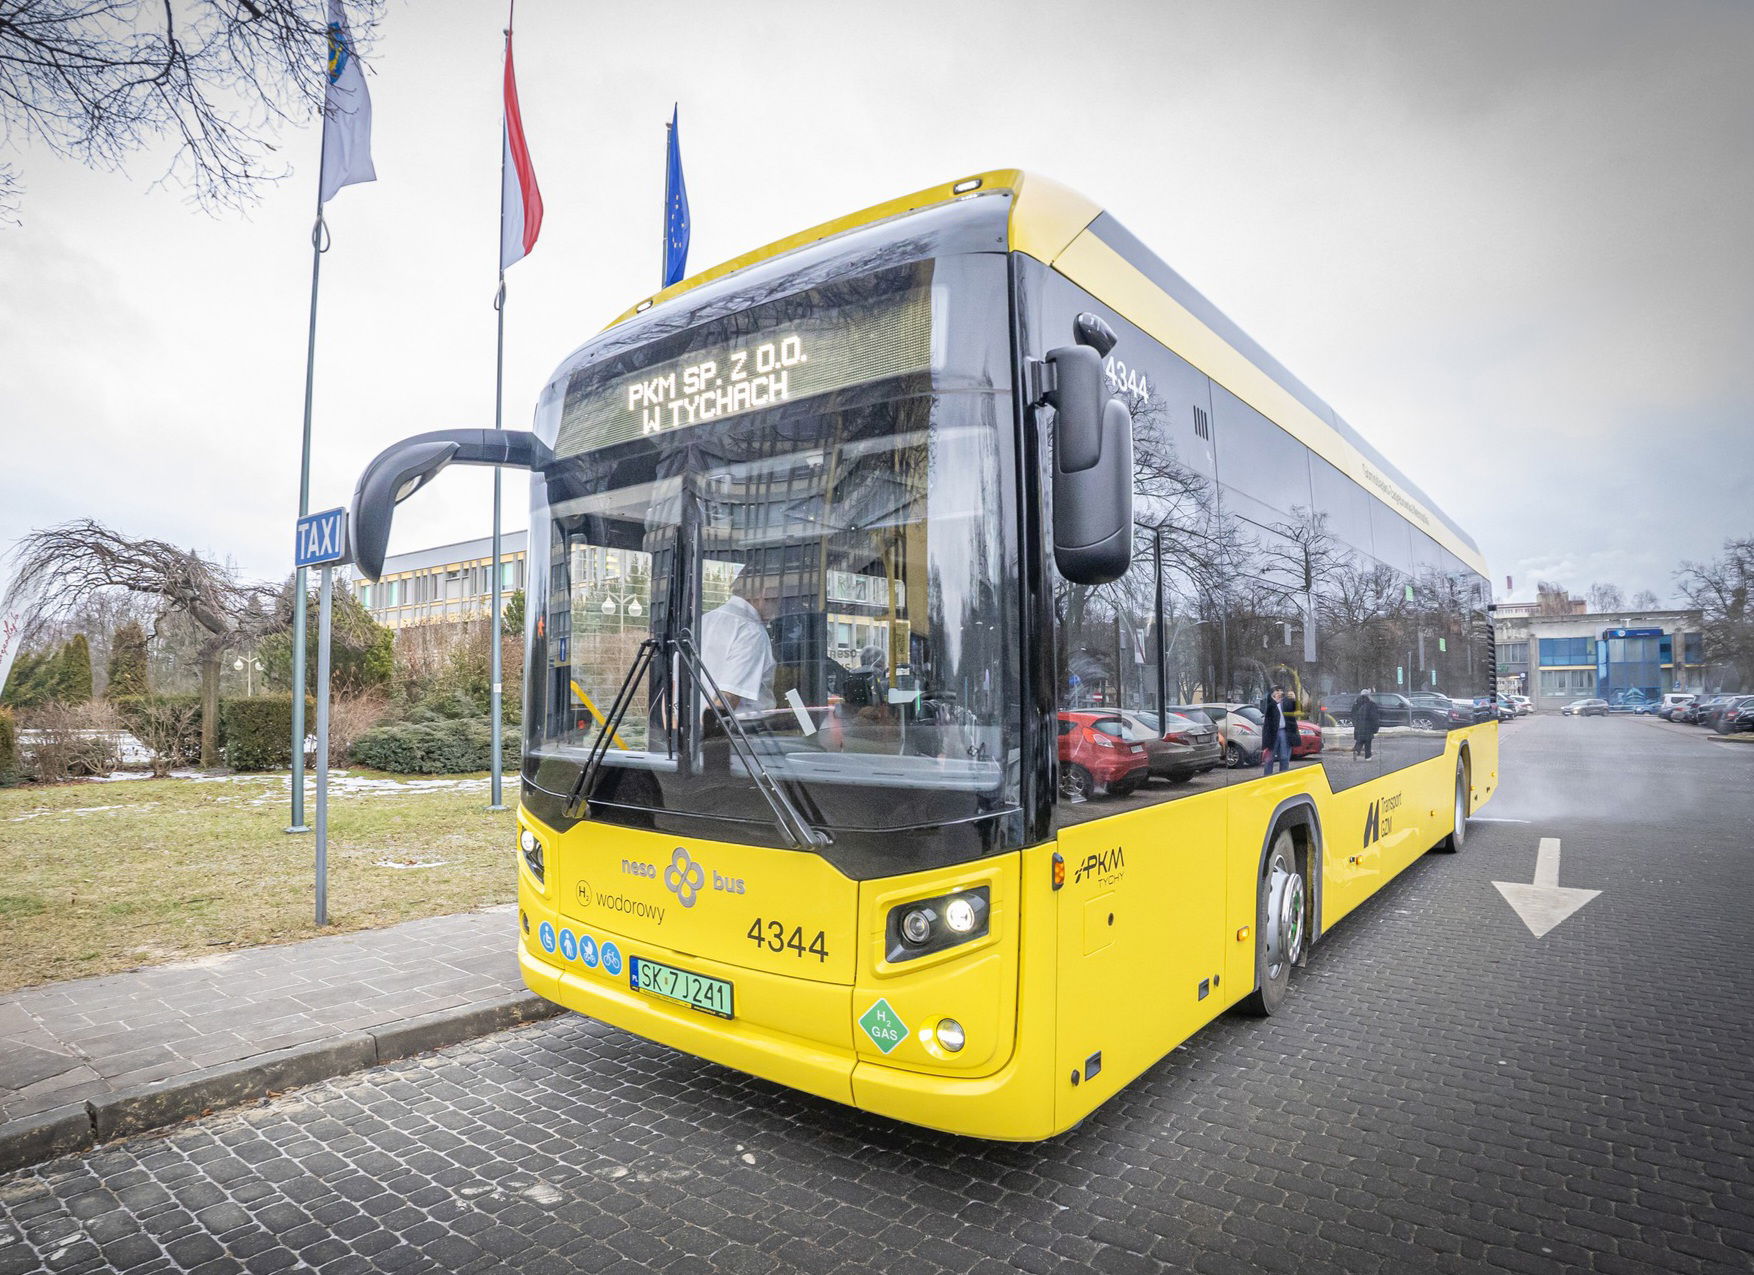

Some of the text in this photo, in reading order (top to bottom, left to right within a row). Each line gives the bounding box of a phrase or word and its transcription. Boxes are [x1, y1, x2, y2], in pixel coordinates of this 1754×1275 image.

[628, 335, 807, 411] PKM SP. Z O.O.
[1105, 356, 1149, 404] 4344
[642, 371, 789, 434] W TYCHACH
[298, 515, 341, 559] TAXI
[621, 859, 746, 894] neso bus
[1082, 846, 1124, 879] PKM
[596, 891, 665, 926] wodorowy
[747, 917, 829, 963] 4344
[641, 963, 662, 992] SK
[669, 971, 723, 1010] 7J241
[871, 1026, 898, 1041] GAS
